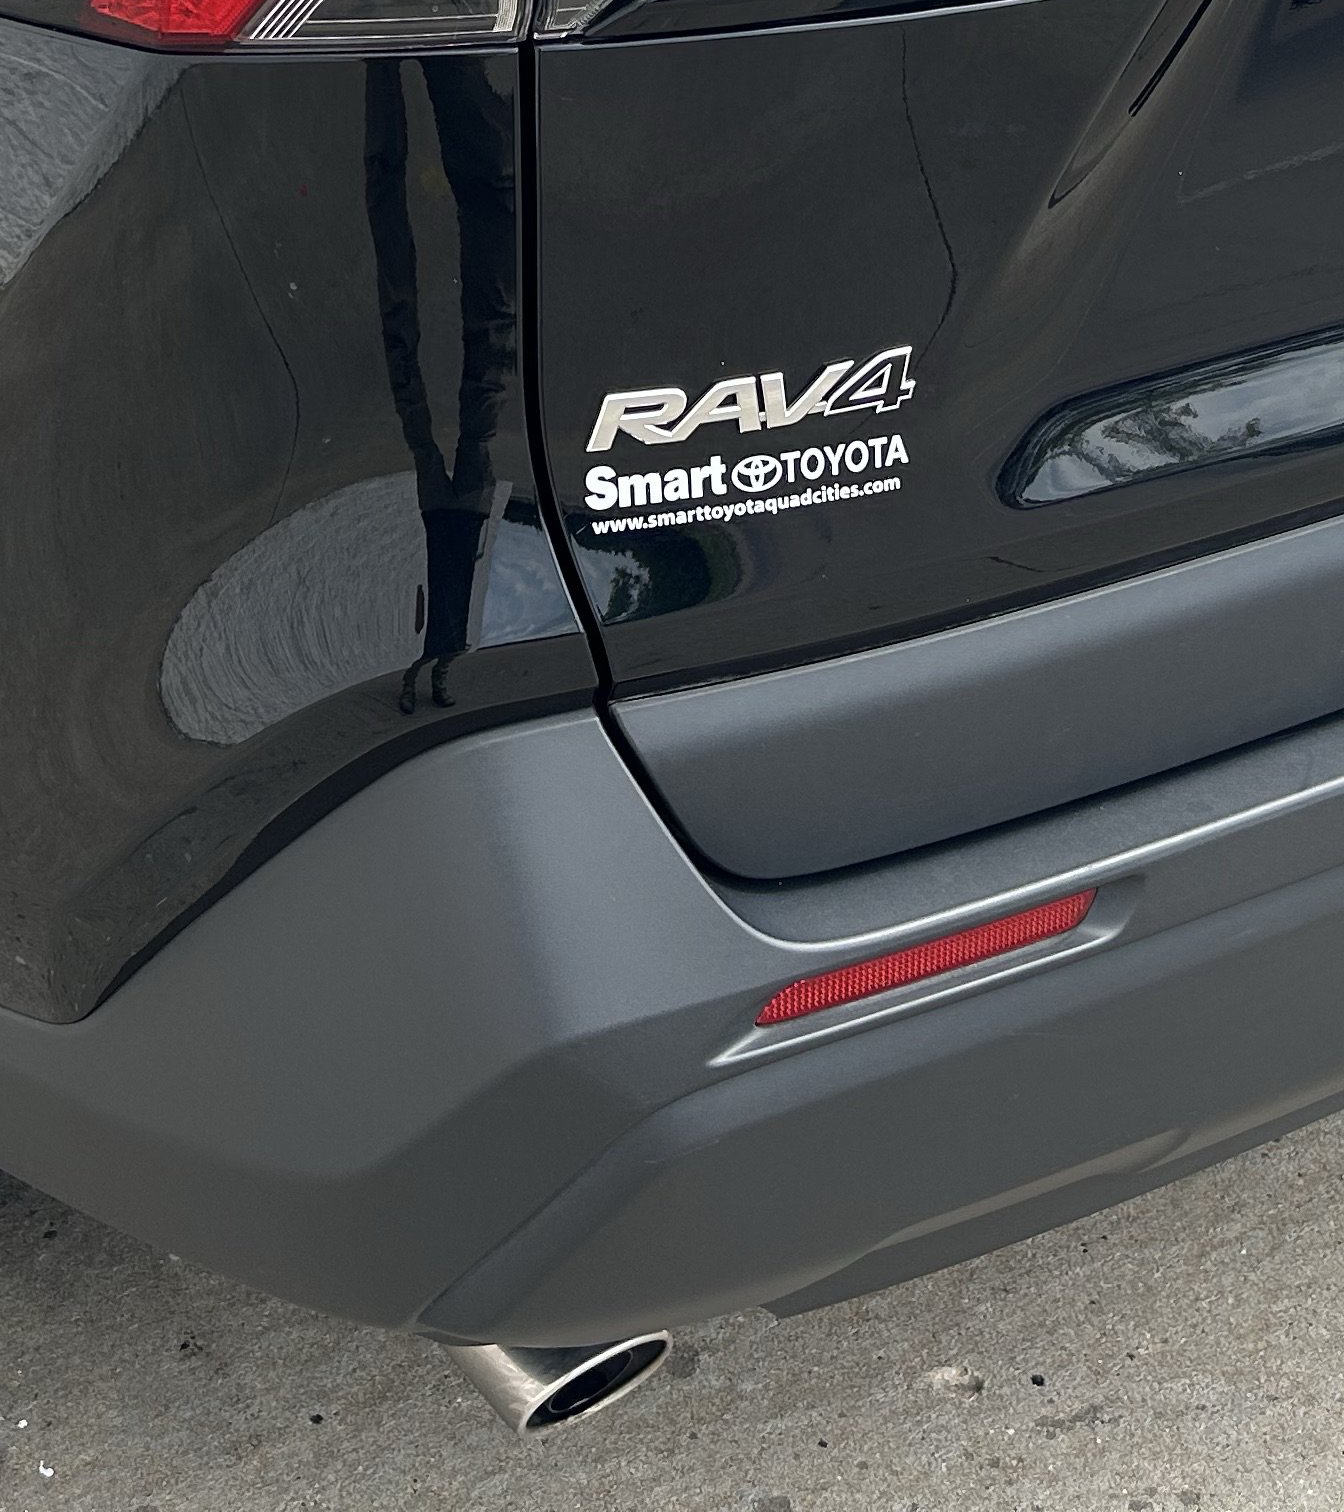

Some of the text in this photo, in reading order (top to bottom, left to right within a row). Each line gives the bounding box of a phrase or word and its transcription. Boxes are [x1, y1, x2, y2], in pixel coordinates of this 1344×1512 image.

[586, 345, 917, 452] RAV4
[584, 434, 910, 511] Smart TOYOTA
[592, 475, 901, 535] www.smarttoyotaquadcities.com
